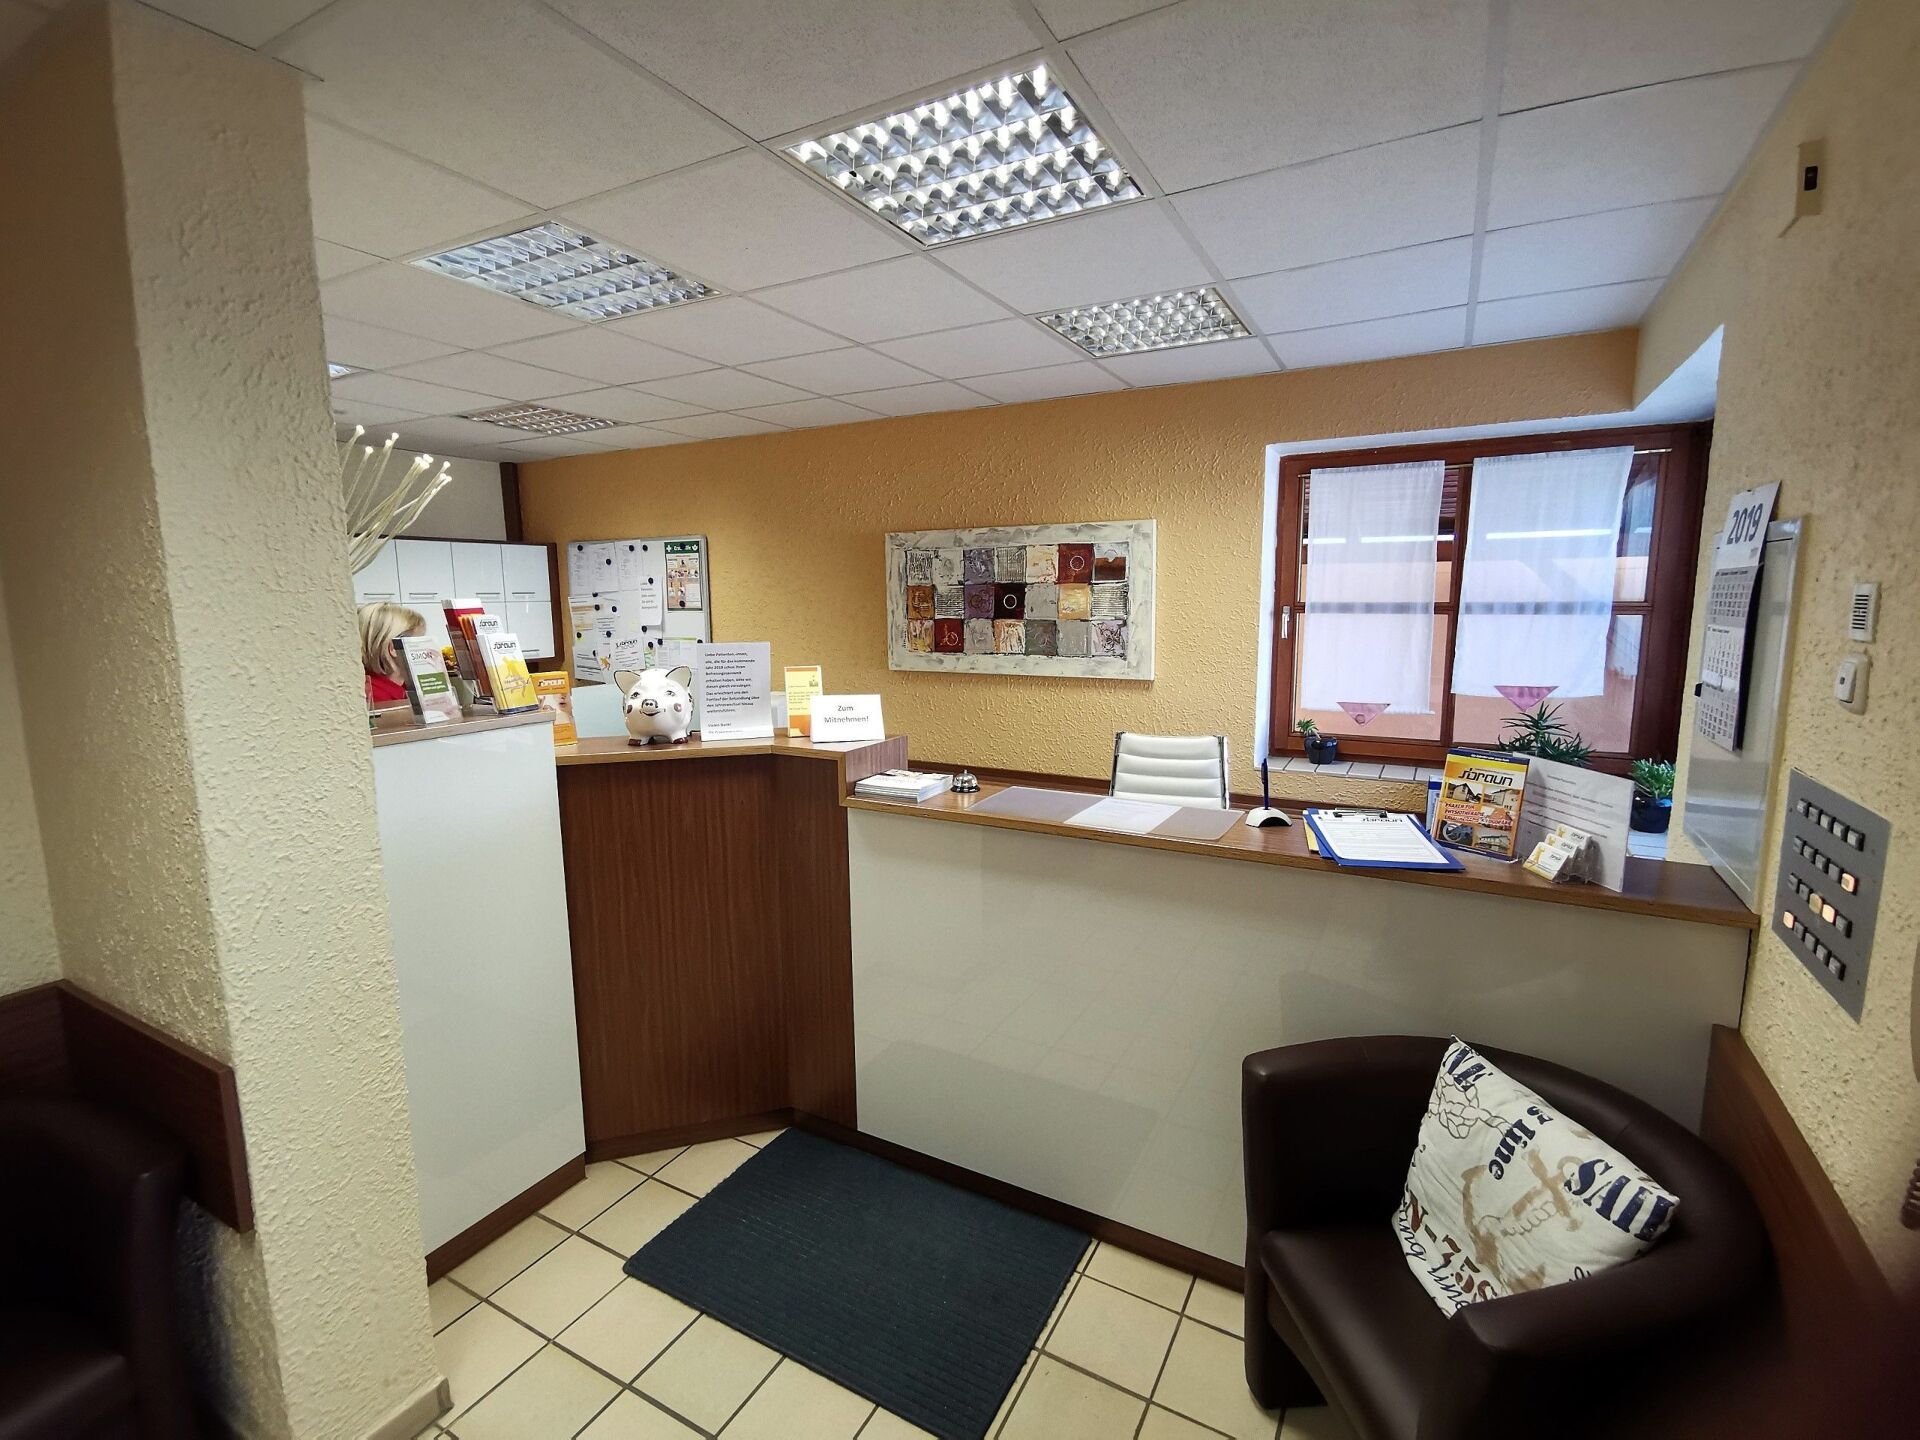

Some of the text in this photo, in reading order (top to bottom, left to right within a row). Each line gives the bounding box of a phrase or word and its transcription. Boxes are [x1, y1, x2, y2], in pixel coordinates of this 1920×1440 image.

[1726, 503, 1765, 546] 2019
[823, 715, 869, 724] Mitnehmen!
[837, 704, 854, 712] Zum
[1487, 1118, 1537, 1182] line
